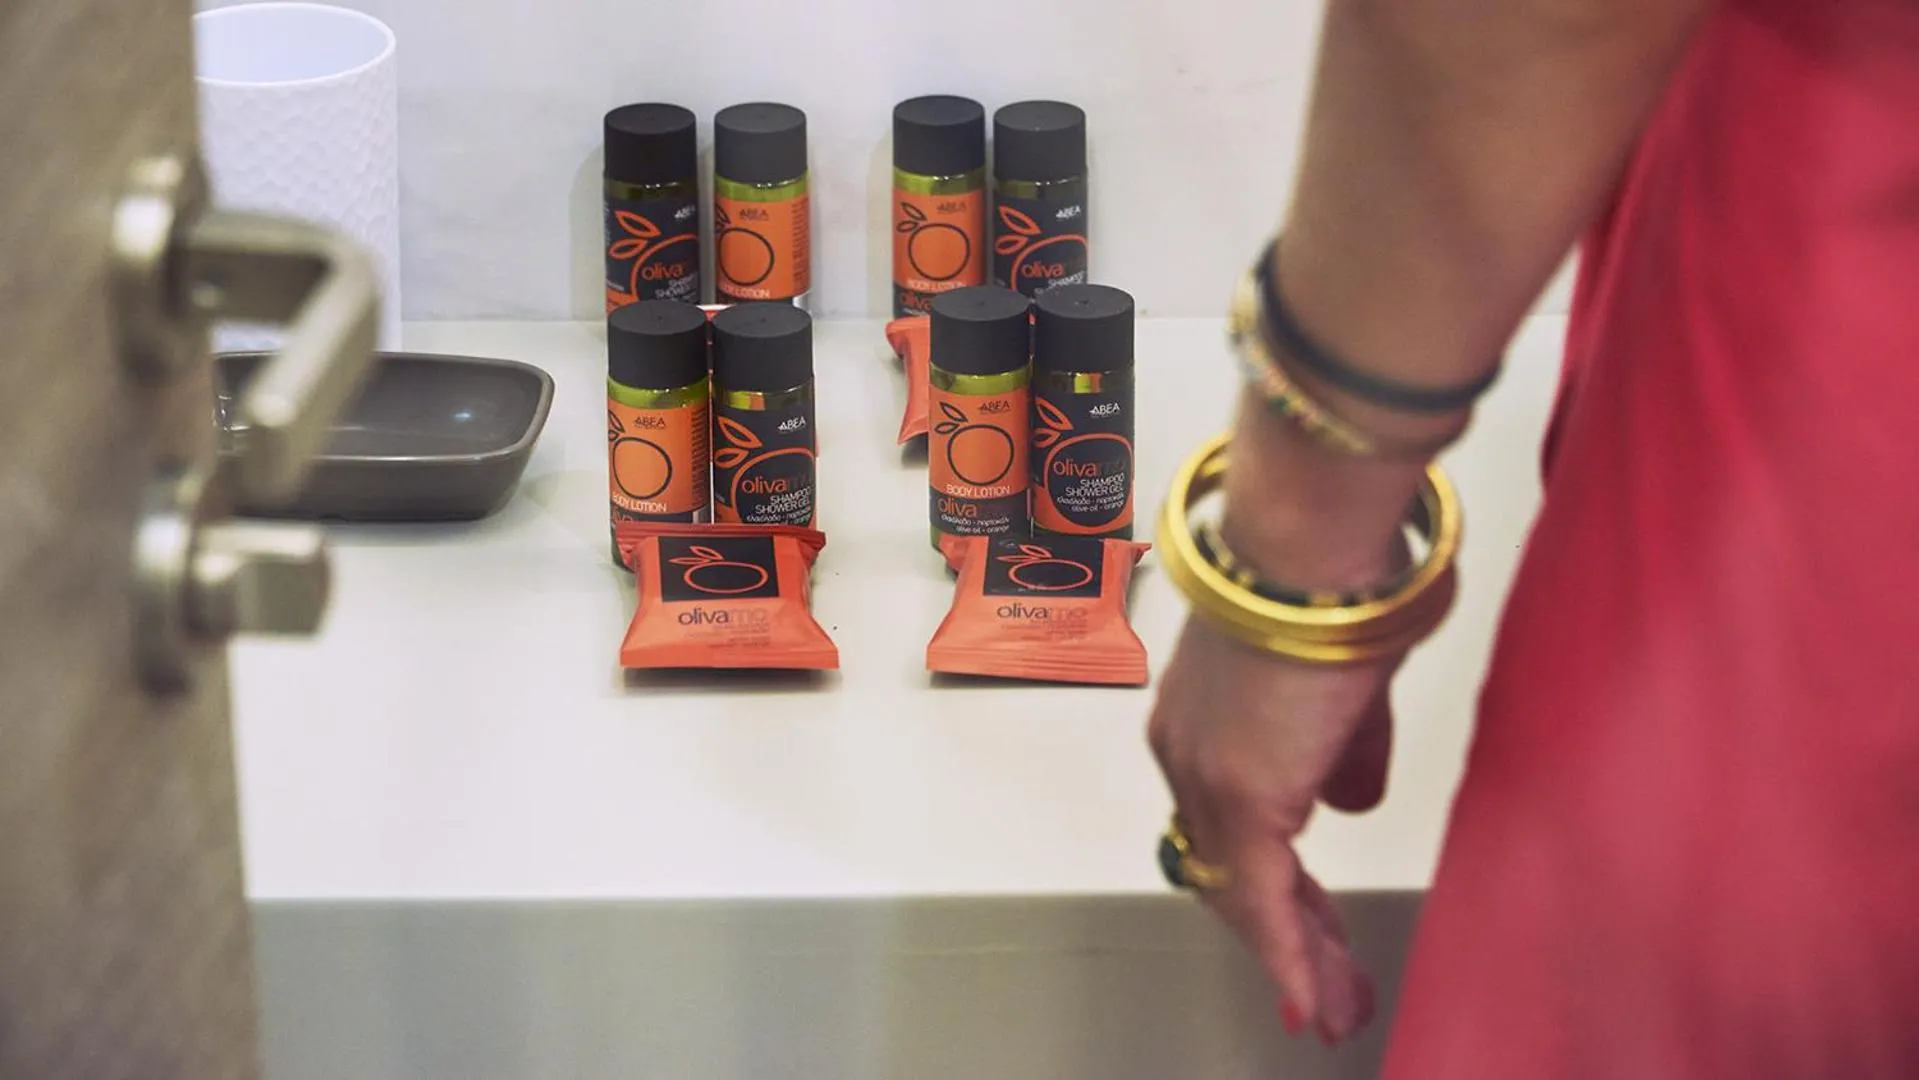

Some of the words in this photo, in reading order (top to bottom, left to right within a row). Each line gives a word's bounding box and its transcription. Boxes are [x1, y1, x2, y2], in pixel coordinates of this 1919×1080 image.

[1089, 402, 1120, 416] ABEA
[778, 416, 806, 431] ABEA
[1080, 472, 1125, 490] SHAMPOO
[946, 484, 971, 498] BODY
[974, 485, 1011, 499] LOTION
[1065, 485, 1108, 499] SHOWER
[631, 499, 667, 513] LOTION
[755, 500, 798, 515] SHOWER
